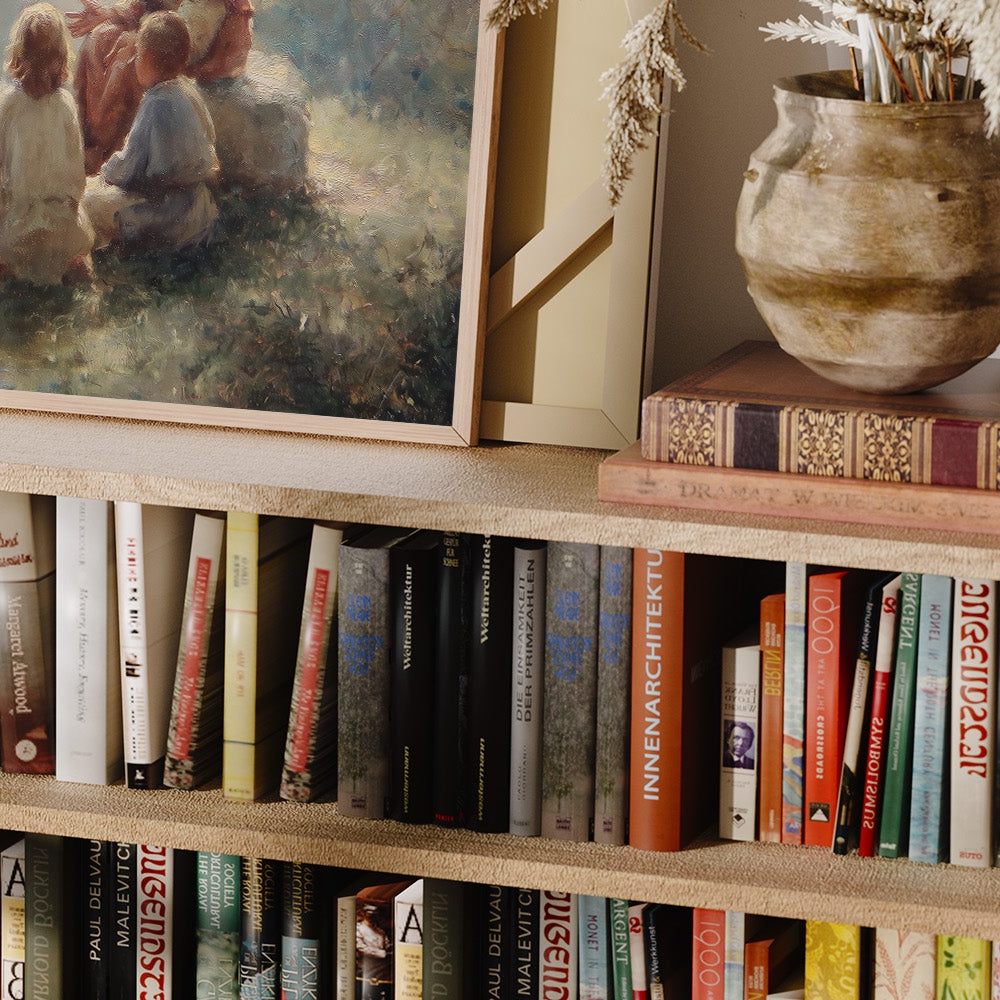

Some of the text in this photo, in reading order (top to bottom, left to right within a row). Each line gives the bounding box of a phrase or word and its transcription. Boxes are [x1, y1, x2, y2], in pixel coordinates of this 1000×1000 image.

[403, 563, 413, 671] Weltarchitektur
[524, 559, 535, 722] DER PRIMZAHLEN
[6, 594, 33, 715] Margaret Atwood
[89, 916, 101, 961] PAUL
[587, 914, 599, 952] MONET
[628, 916, 642, 934] 2
[648, 925, 660, 975] Werkkunst
[694, 921, 721, 987] 1900
[488, 963, 501, 1000] AUL
